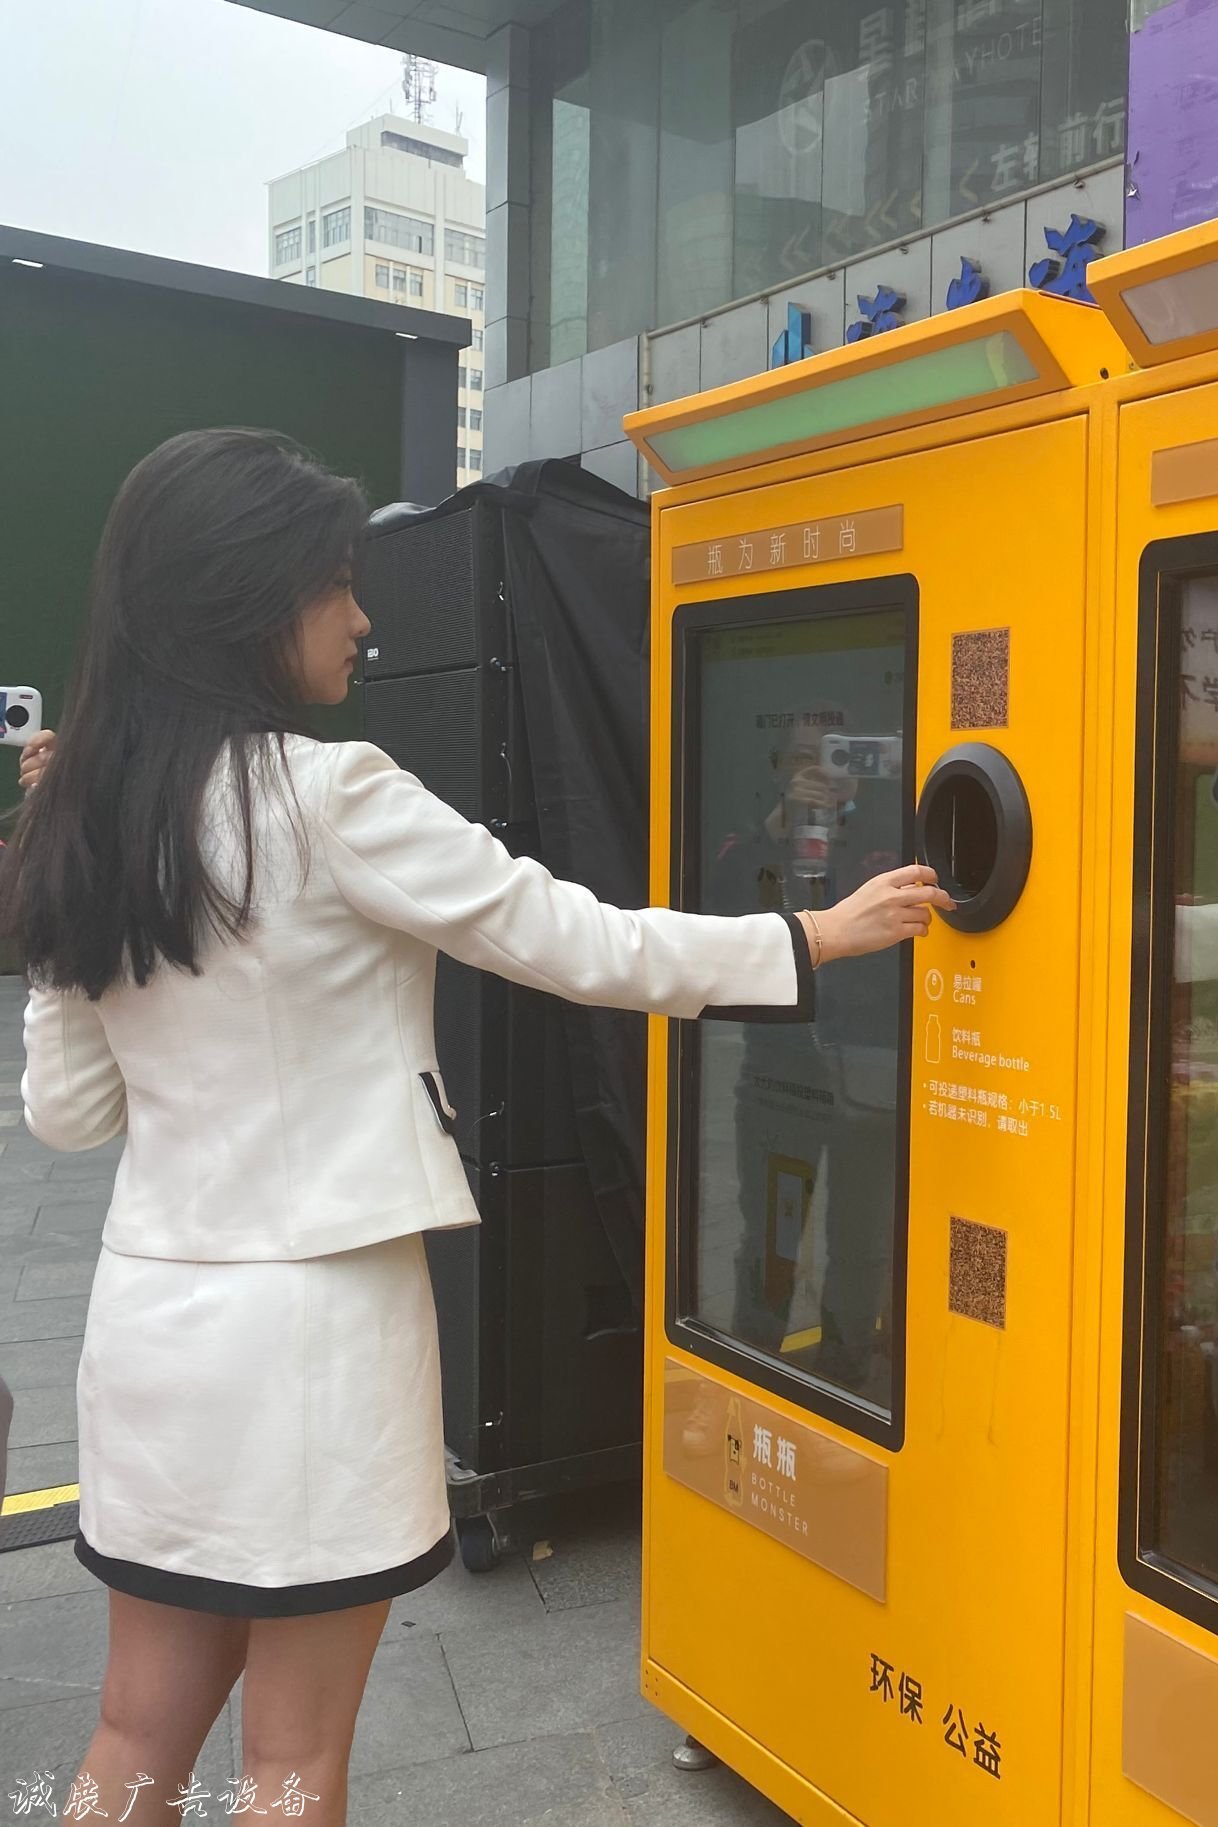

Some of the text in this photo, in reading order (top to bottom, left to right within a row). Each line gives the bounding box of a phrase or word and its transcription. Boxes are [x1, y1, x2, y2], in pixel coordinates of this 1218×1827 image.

[707, 520, 856, 575] 瓶为新时尚
[953, 974, 982, 992] 易拉罐
[953, 990, 976, 1005] Cans
[952, 1028, 981, 1047] 饮料瓶
[952, 1046, 1030, 1072] Beverage bottle
[753, 1423, 797, 1481] 瓶瓶
[751, 1472, 796, 1507] BOTTLE
[751, 1492, 808, 1537] MONSTER
[870, 1653, 1001, 1780] 环保 公益
